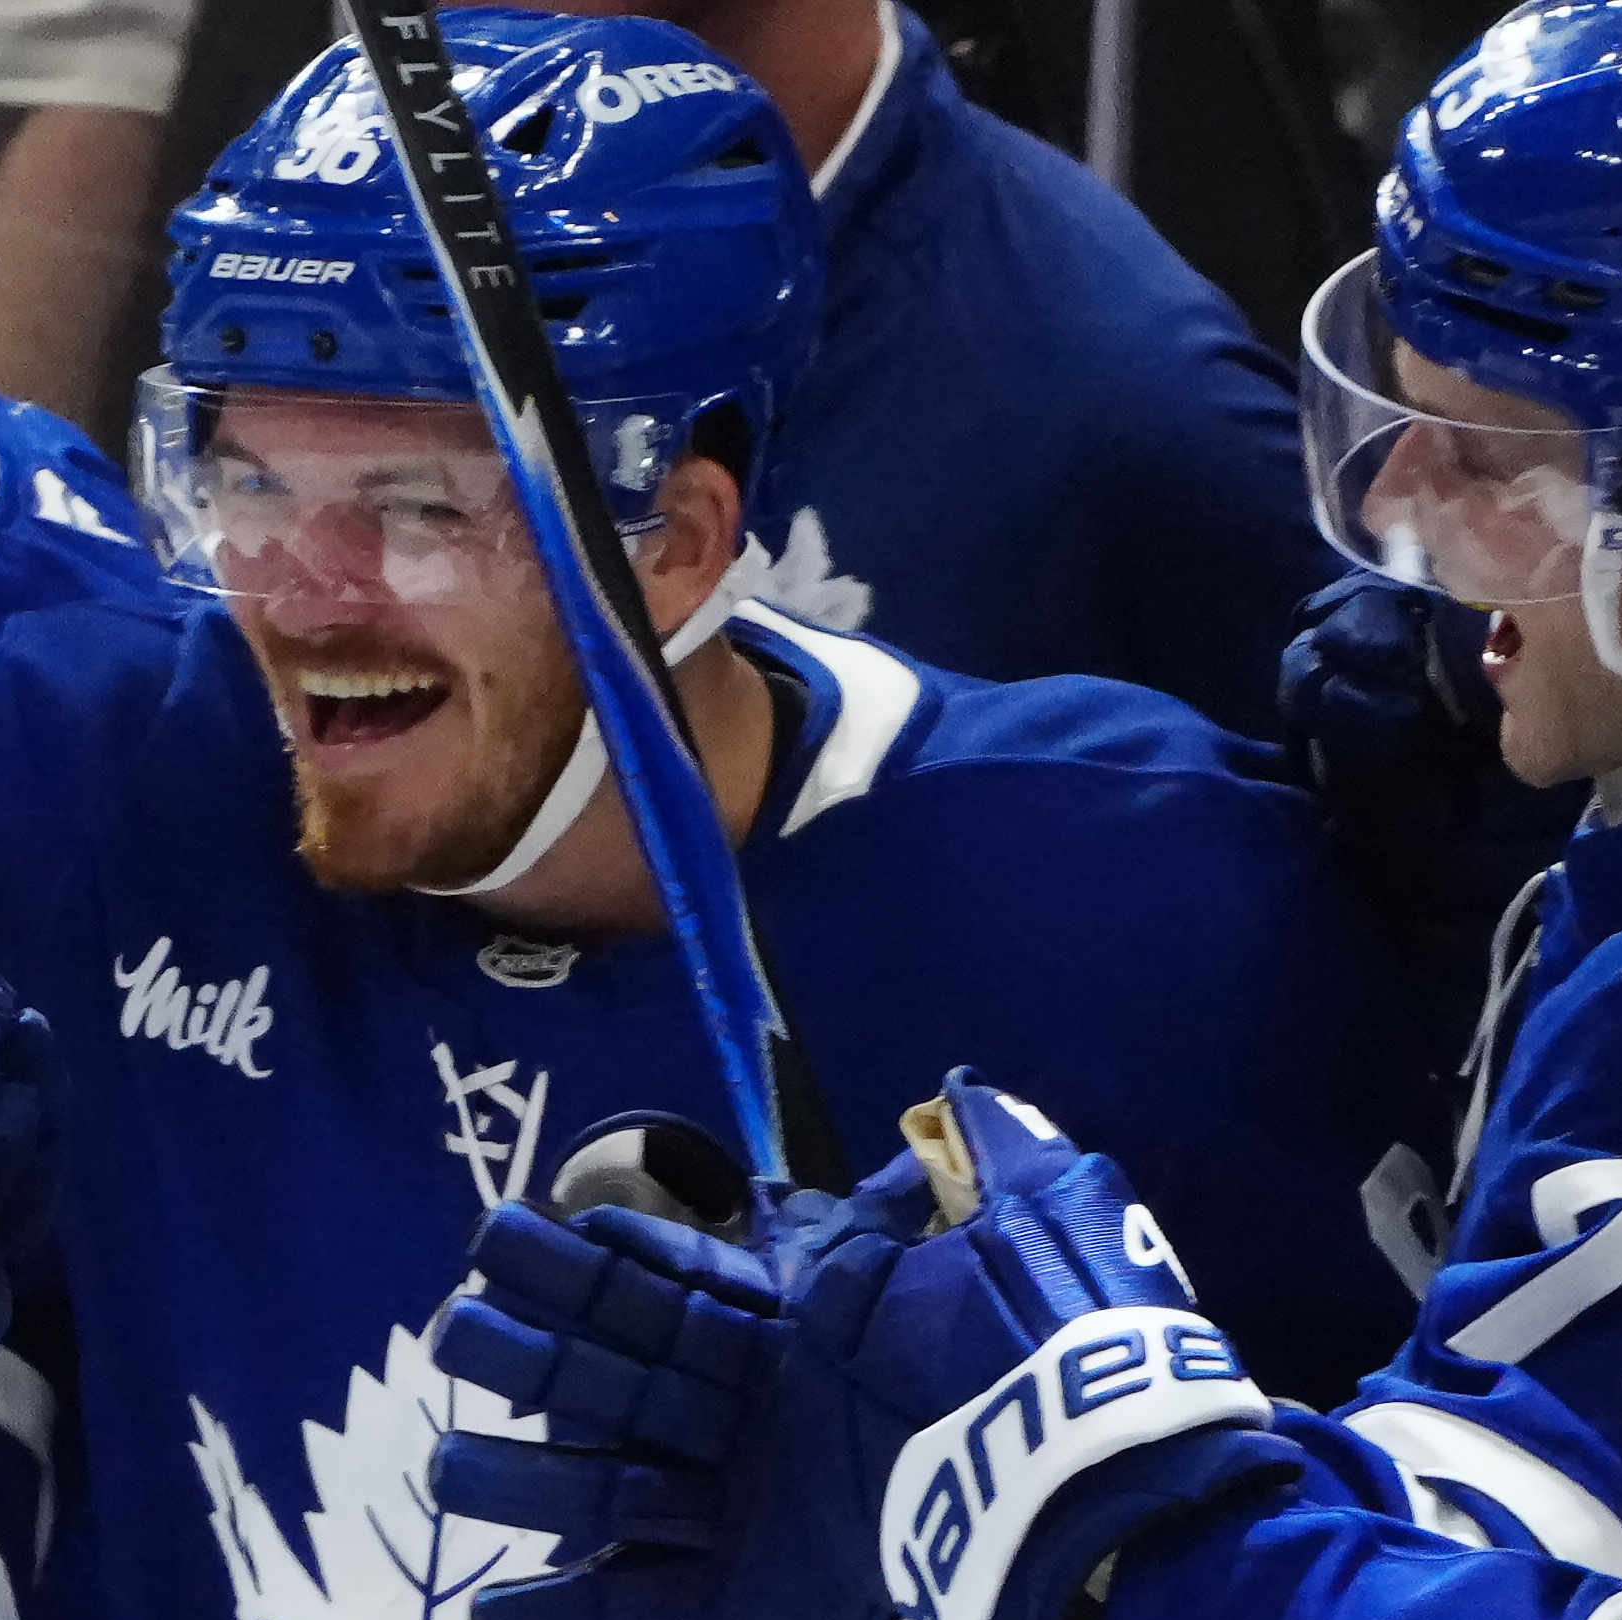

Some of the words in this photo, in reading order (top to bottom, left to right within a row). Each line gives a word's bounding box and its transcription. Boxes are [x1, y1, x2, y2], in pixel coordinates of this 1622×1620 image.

[575, 62, 736, 124] OREO
[380, 15, 516, 290] FLYLITE
[210, 253, 355, 284] BAUER
[114, 936, 273, 1078] Milk
